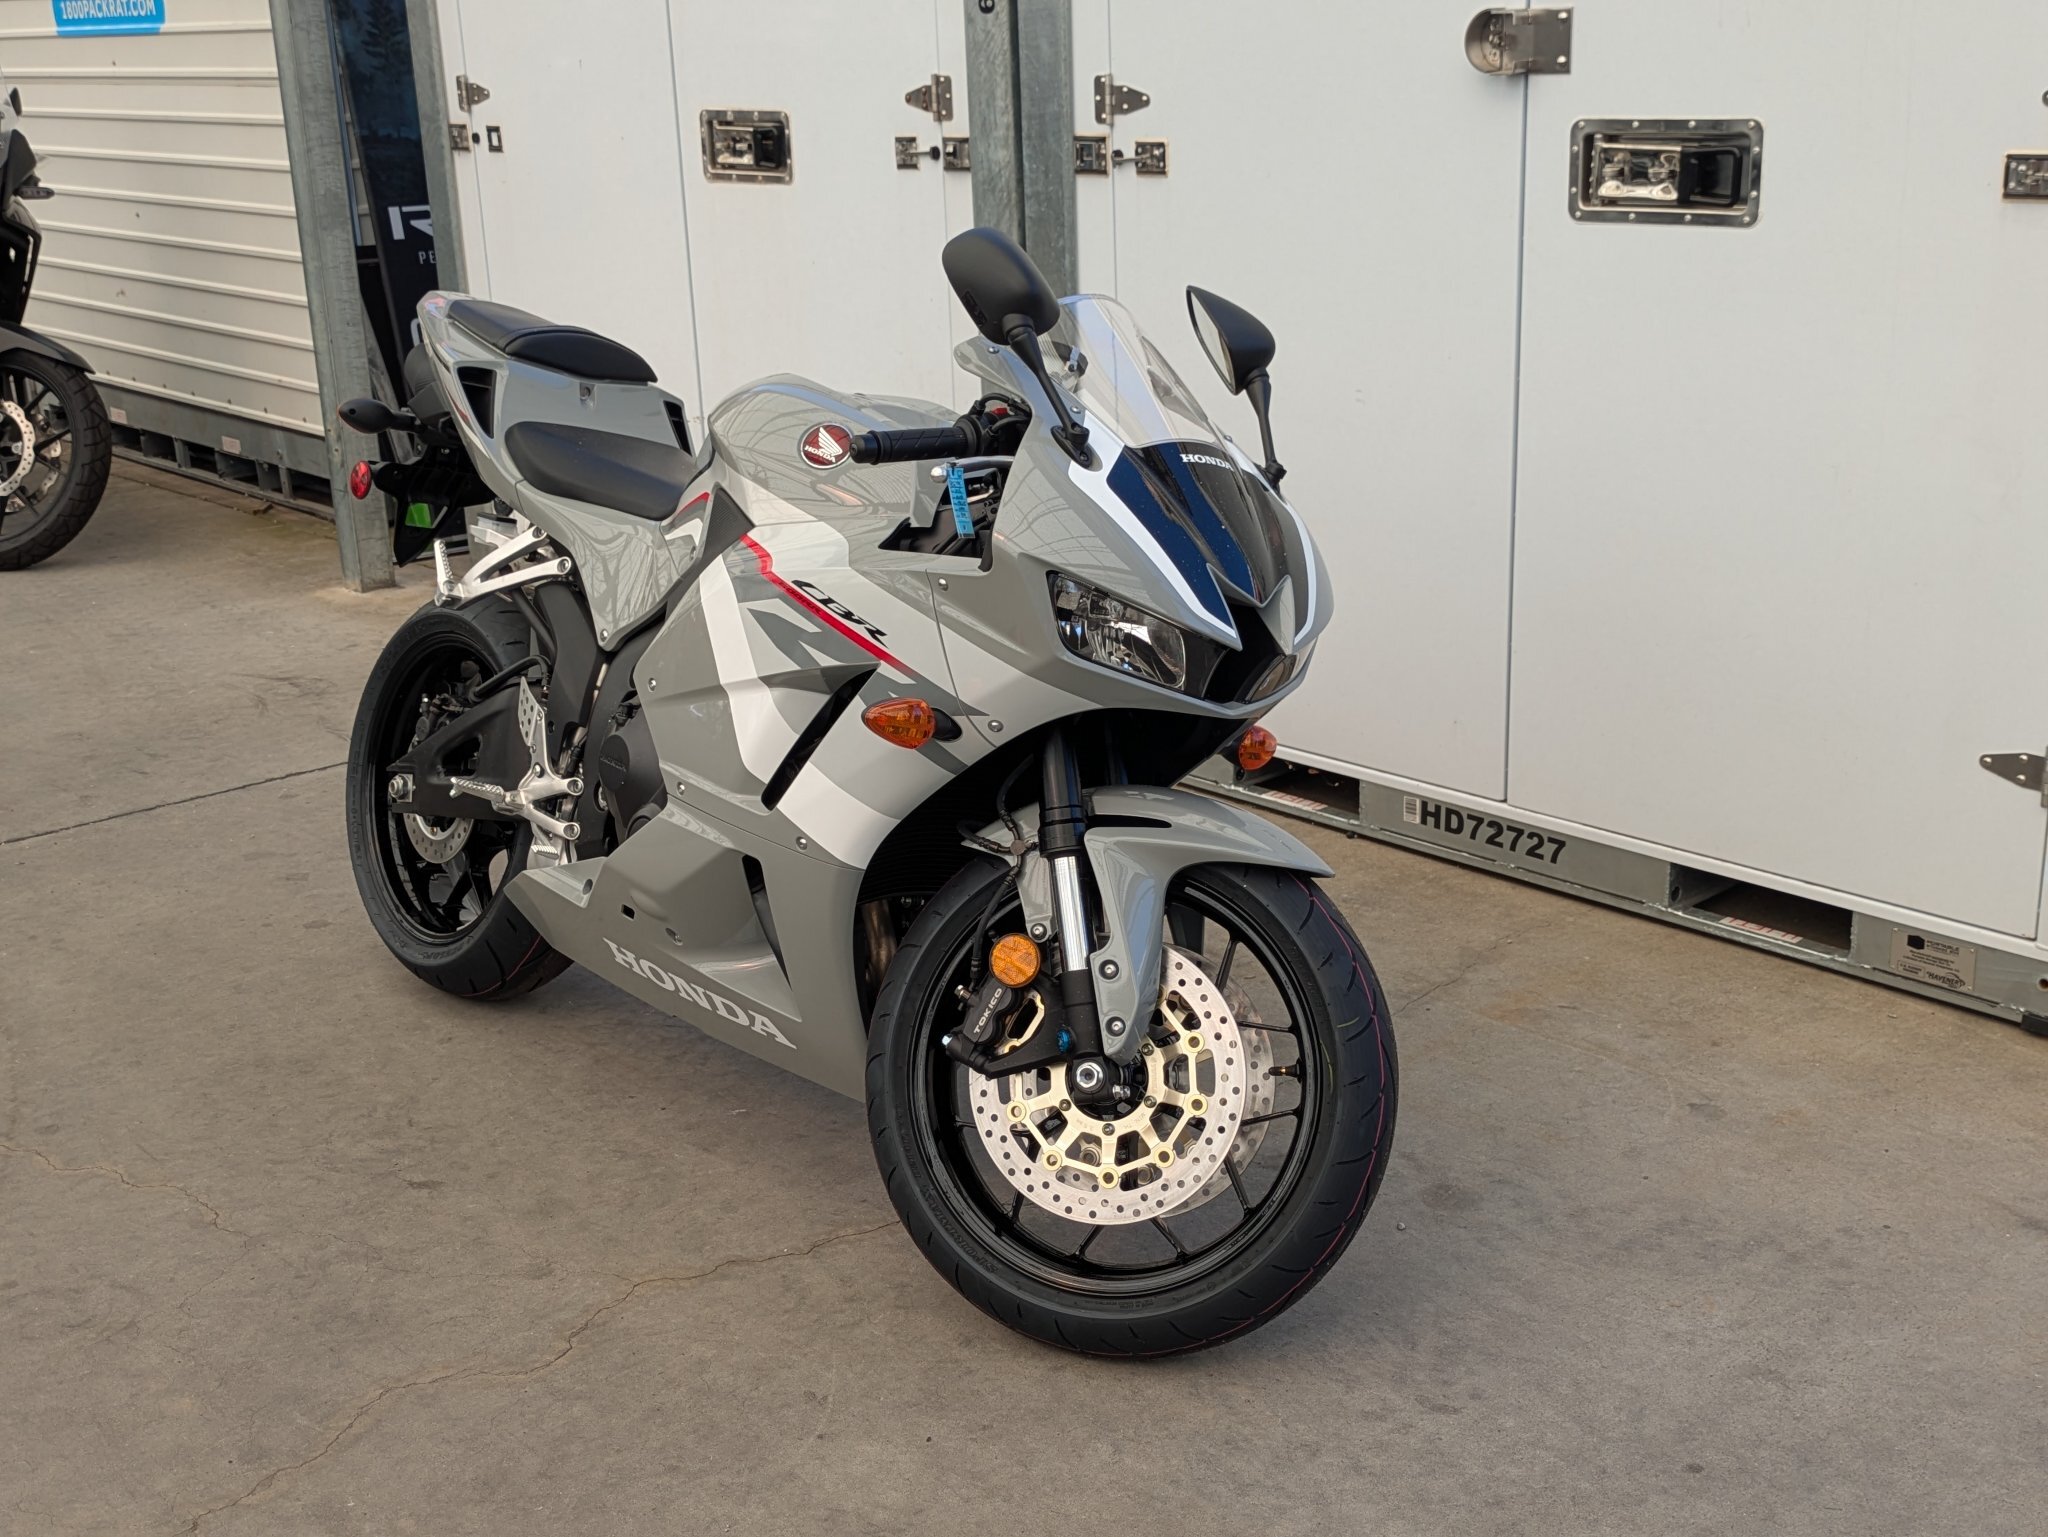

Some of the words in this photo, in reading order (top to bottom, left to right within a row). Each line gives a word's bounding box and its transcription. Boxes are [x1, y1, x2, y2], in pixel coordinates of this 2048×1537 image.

[60, 0, 157, 19] 1800PACKRAT.COM
[804, 444, 836, 463] HONDA
[1179, 453, 1235, 472] HONDA
[791, 579, 889, 650] CBR
[1420, 800, 1567, 865] HD72727
[602, 937, 798, 1050] HONDA
[973, 988, 1003, 1034] TOKICO
